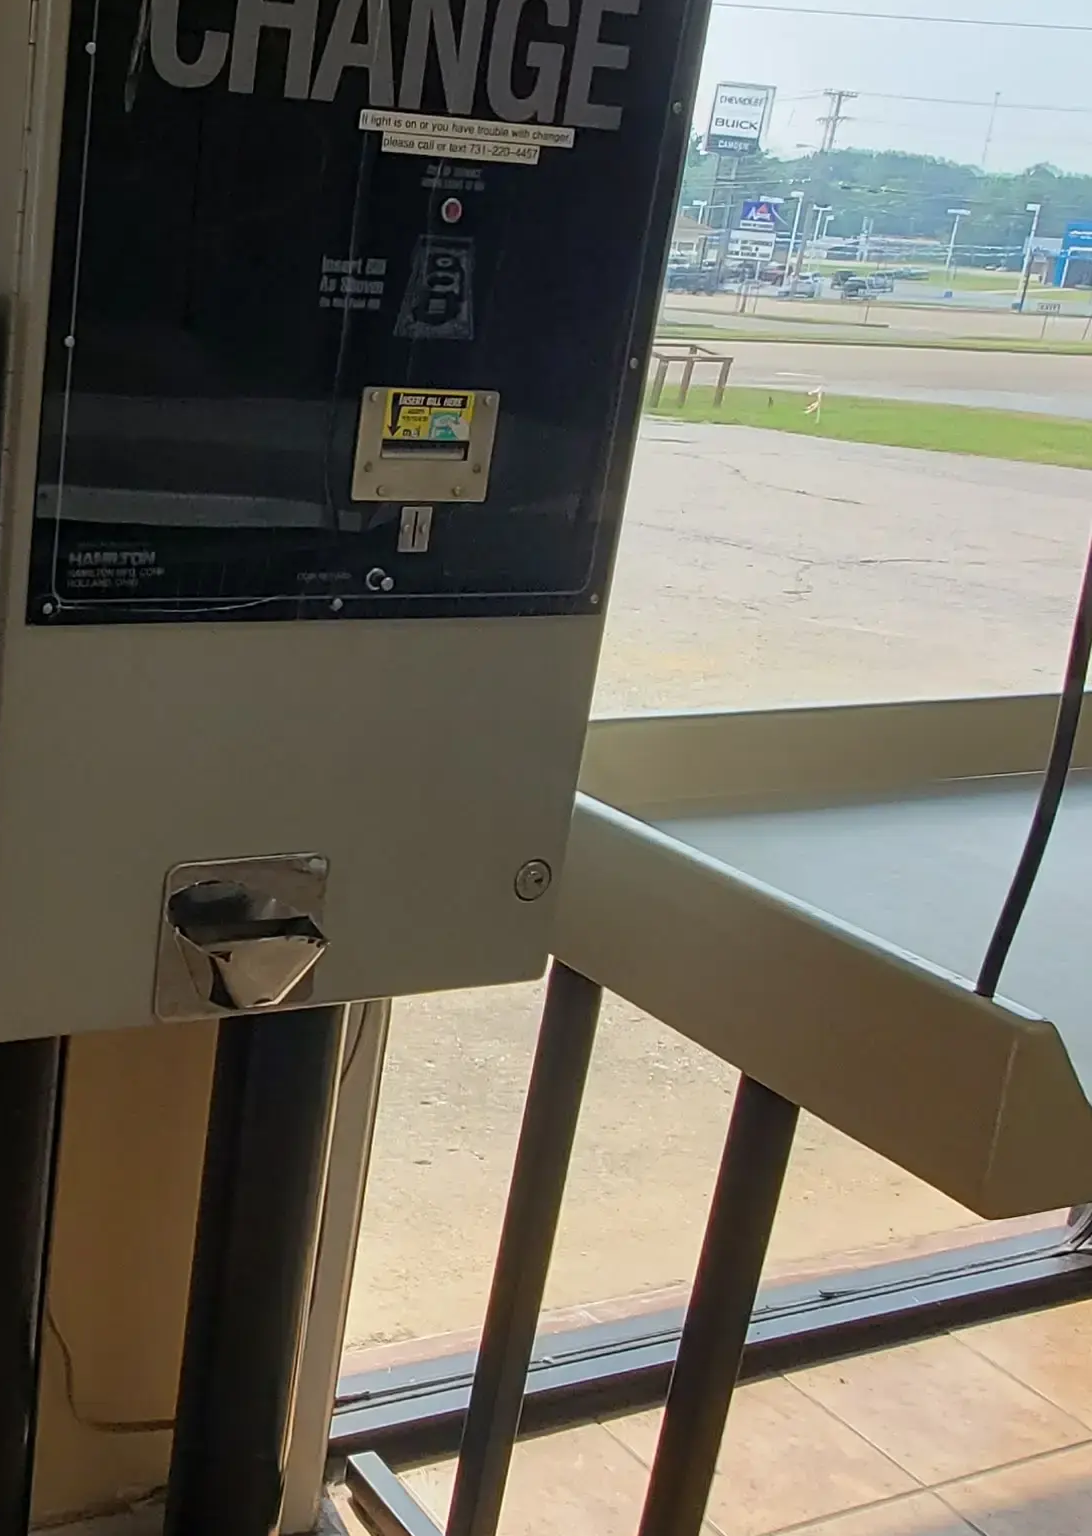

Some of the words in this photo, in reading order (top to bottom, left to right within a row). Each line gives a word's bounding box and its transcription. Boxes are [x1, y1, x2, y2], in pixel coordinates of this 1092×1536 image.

[371, 116, 392, 128] light
[394, 119, 403, 129] is
[405, 120, 417, 129] on
[420, 121, 429, 130] or
[432, 122, 449, 133] you
[452, 123, 475, 135] have
[477, 126, 509, 137] trouble
[511, 129, 530, 139] with
[715, 118, 758, 130] BUICK
[384, 137, 415, 149] please
[418, 140, 435, 150] call
[437, 142, 446, 152] or
[449, 142, 468, 153] text
